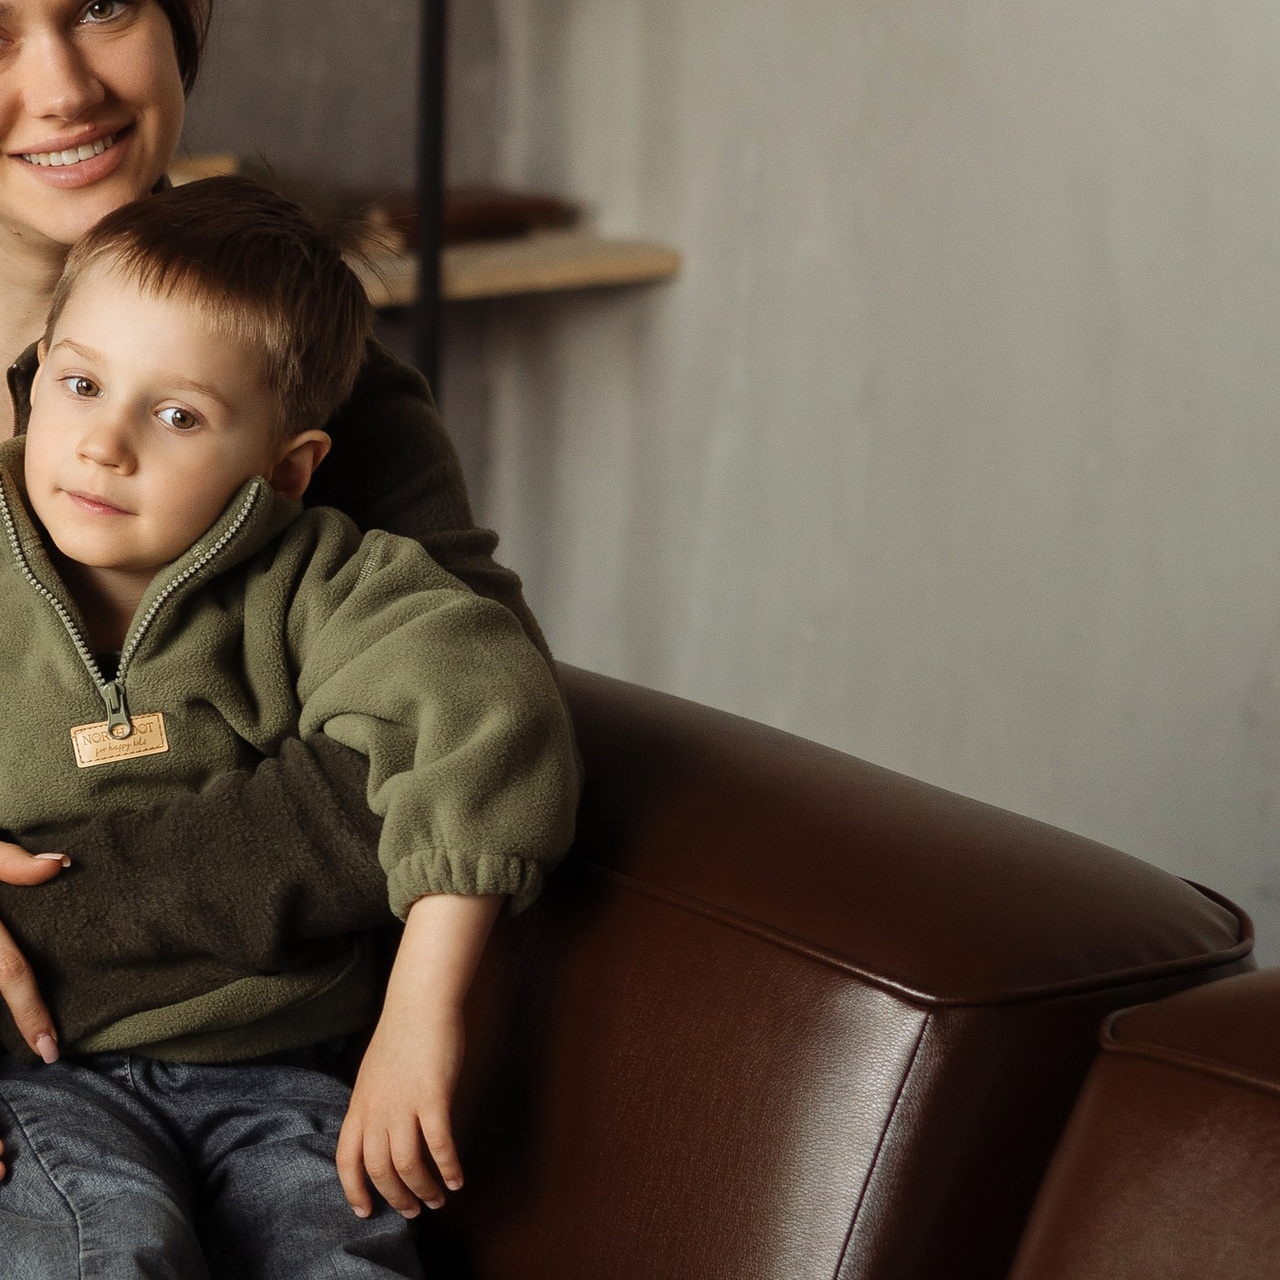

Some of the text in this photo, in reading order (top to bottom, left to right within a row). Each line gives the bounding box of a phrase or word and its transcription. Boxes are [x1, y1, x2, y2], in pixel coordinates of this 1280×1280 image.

[82, 722, 154, 745] NORHOOT
[95, 736, 147, 757] for happy kids
